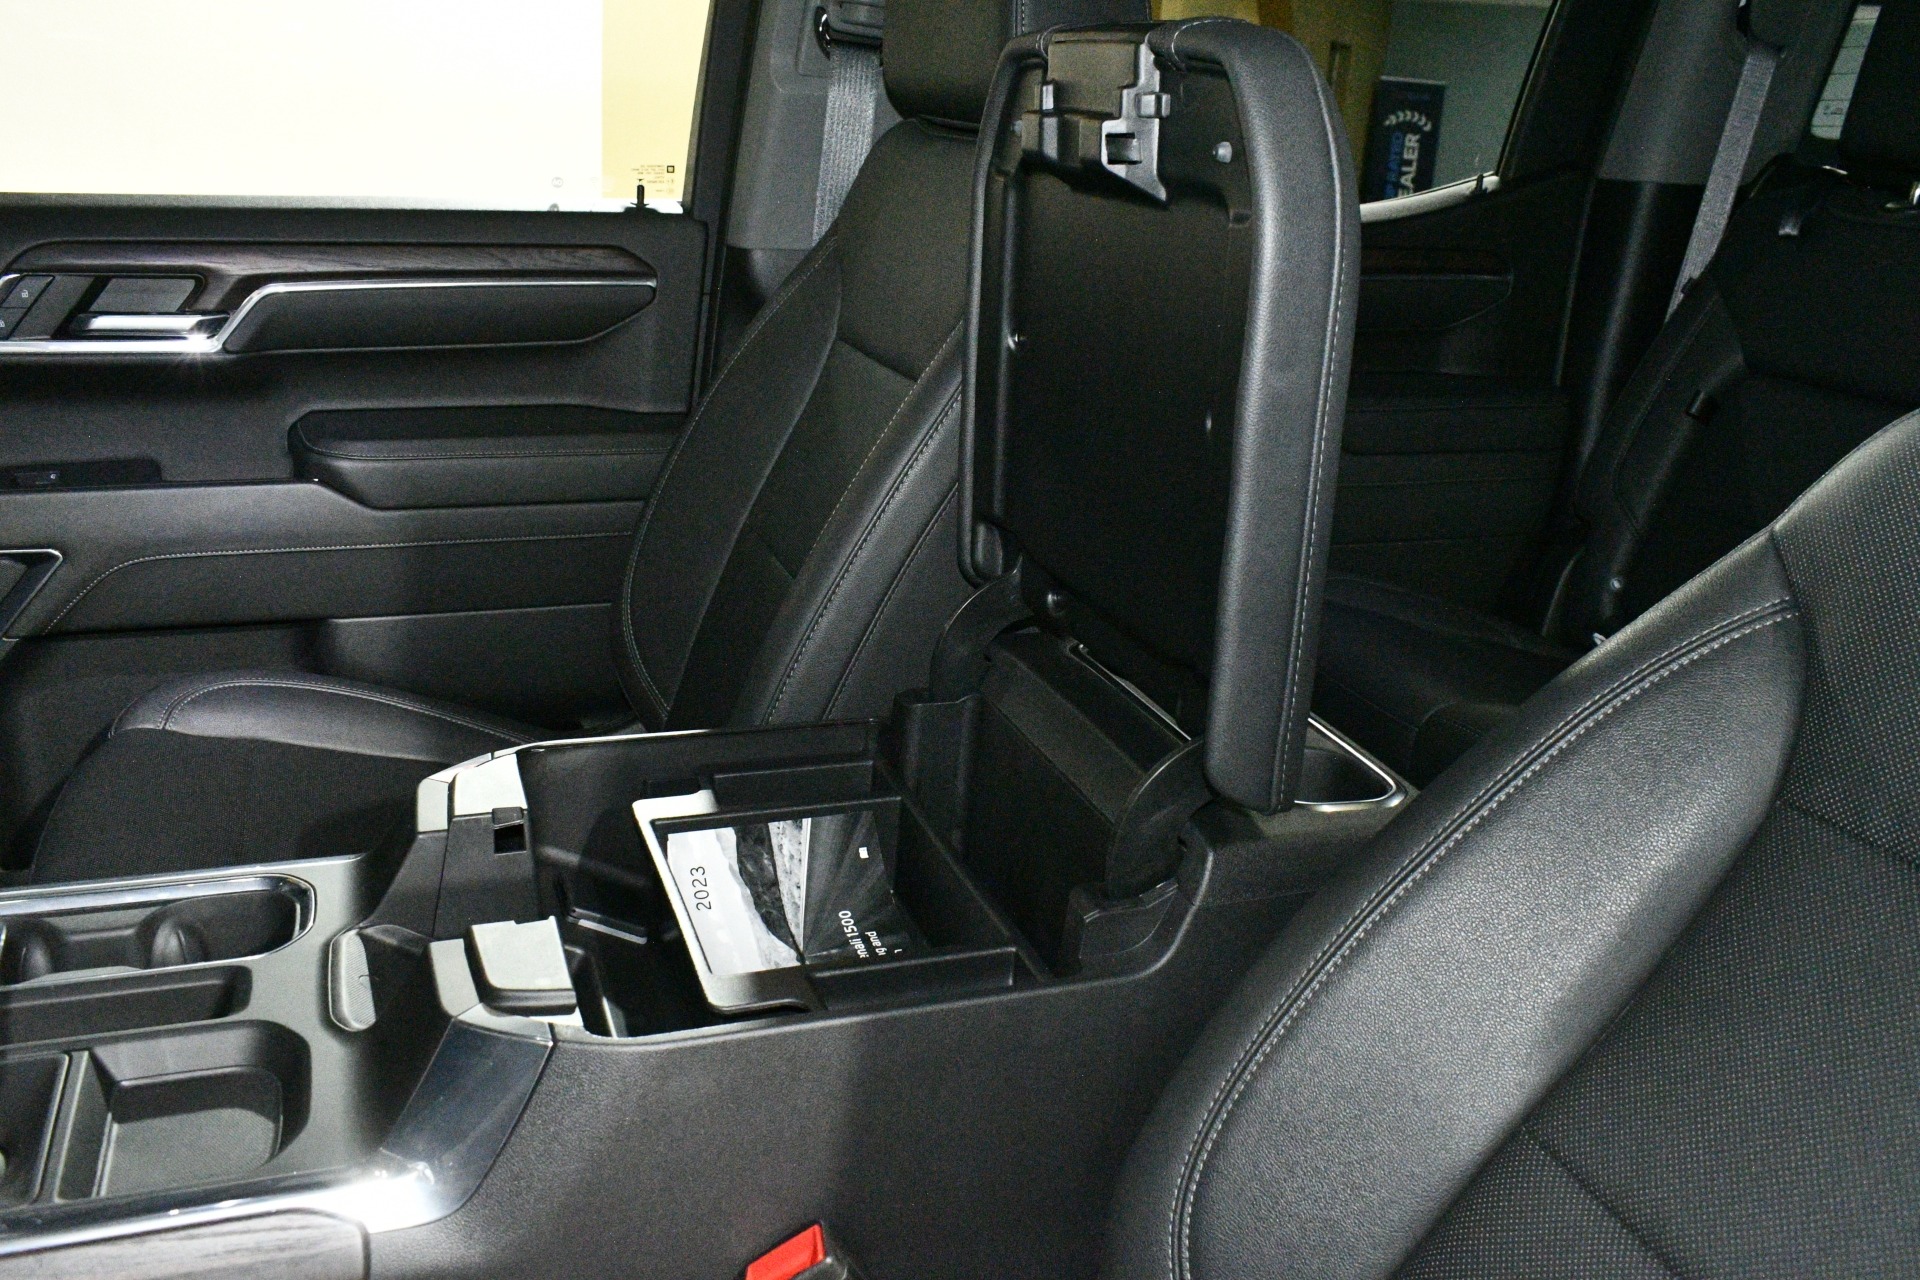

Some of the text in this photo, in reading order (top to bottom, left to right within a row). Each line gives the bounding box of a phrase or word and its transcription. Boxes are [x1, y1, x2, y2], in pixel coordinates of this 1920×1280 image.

[690, 866, 712, 911] 2023
[838, 910, 860, 938] 1500
[864, 931, 882, 947] and
